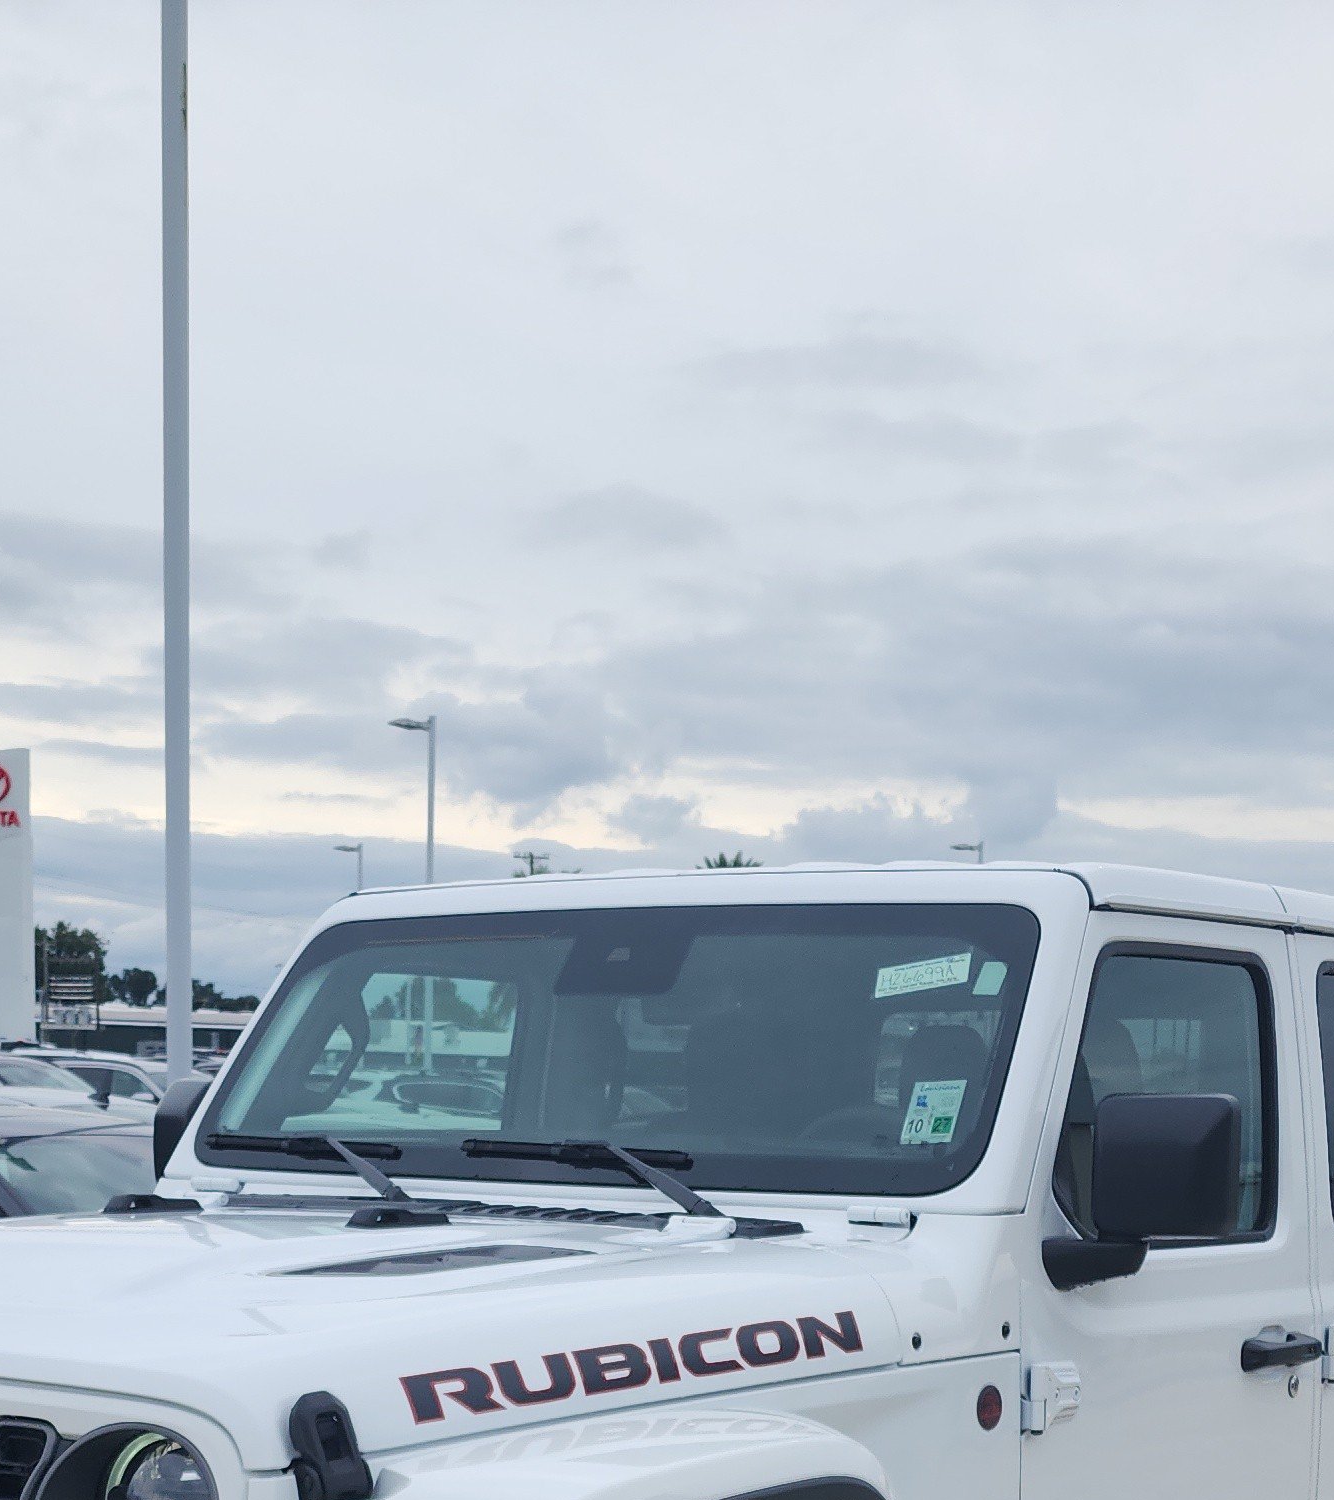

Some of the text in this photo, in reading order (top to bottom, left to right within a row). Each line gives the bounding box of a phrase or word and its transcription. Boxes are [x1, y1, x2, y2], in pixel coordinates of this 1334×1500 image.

[908, 1117, 952, 1134] 10 27
[398, 1310, 864, 1425] RUBICON
